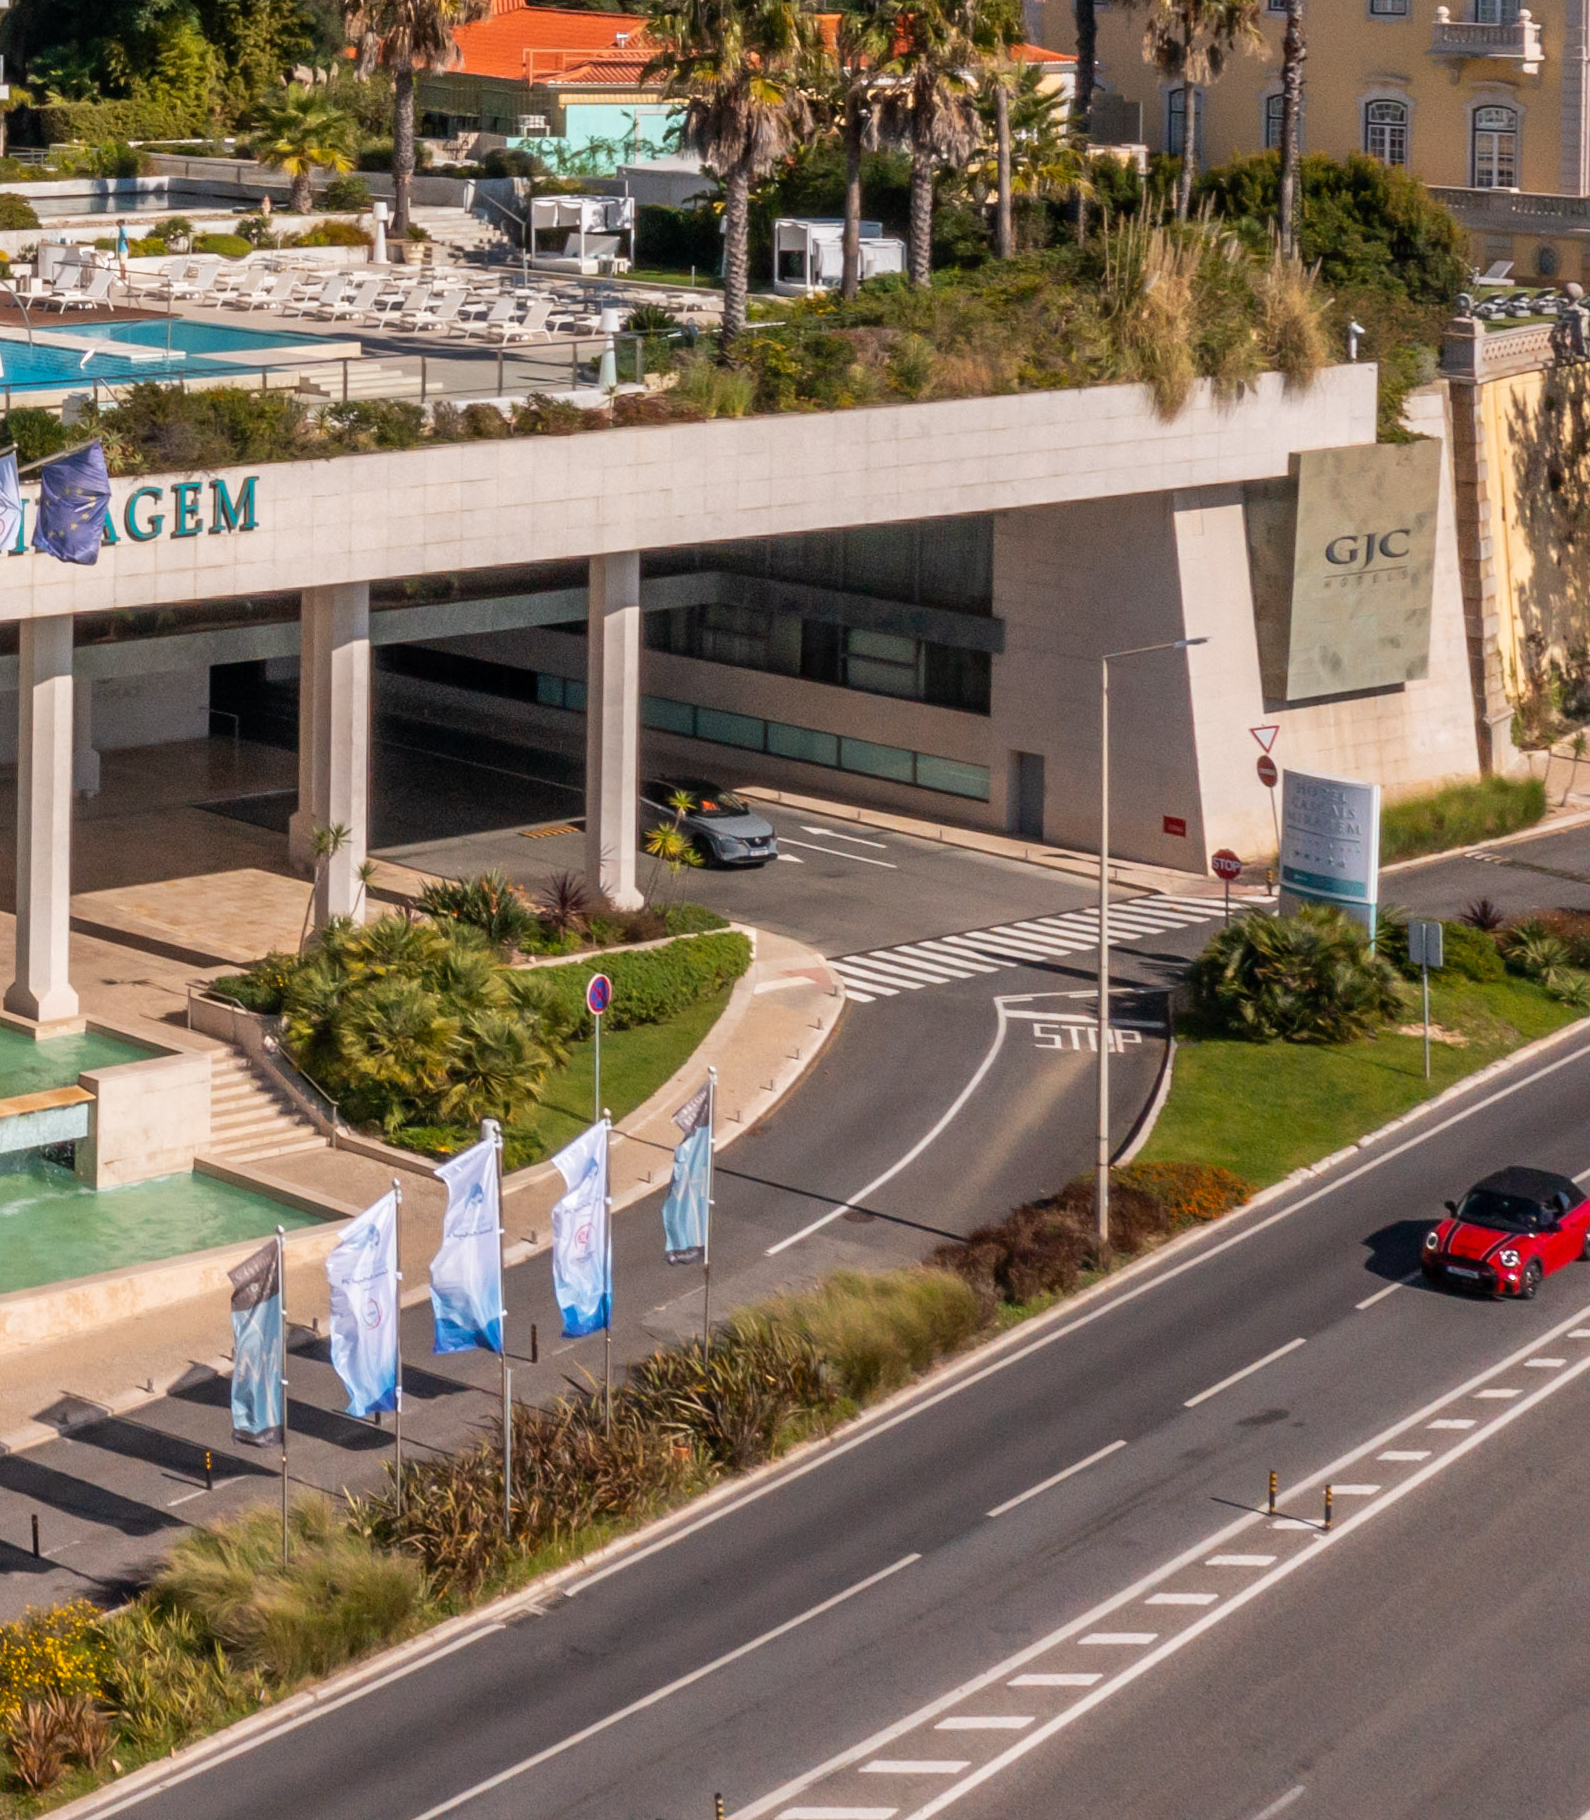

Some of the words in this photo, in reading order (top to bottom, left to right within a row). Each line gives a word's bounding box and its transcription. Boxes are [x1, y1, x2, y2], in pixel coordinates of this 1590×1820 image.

[1325, 528, 1411, 570] GJC
[1212, 857, 1241, 872] STOP
[1033, 1023, 1142, 1053] STOP
